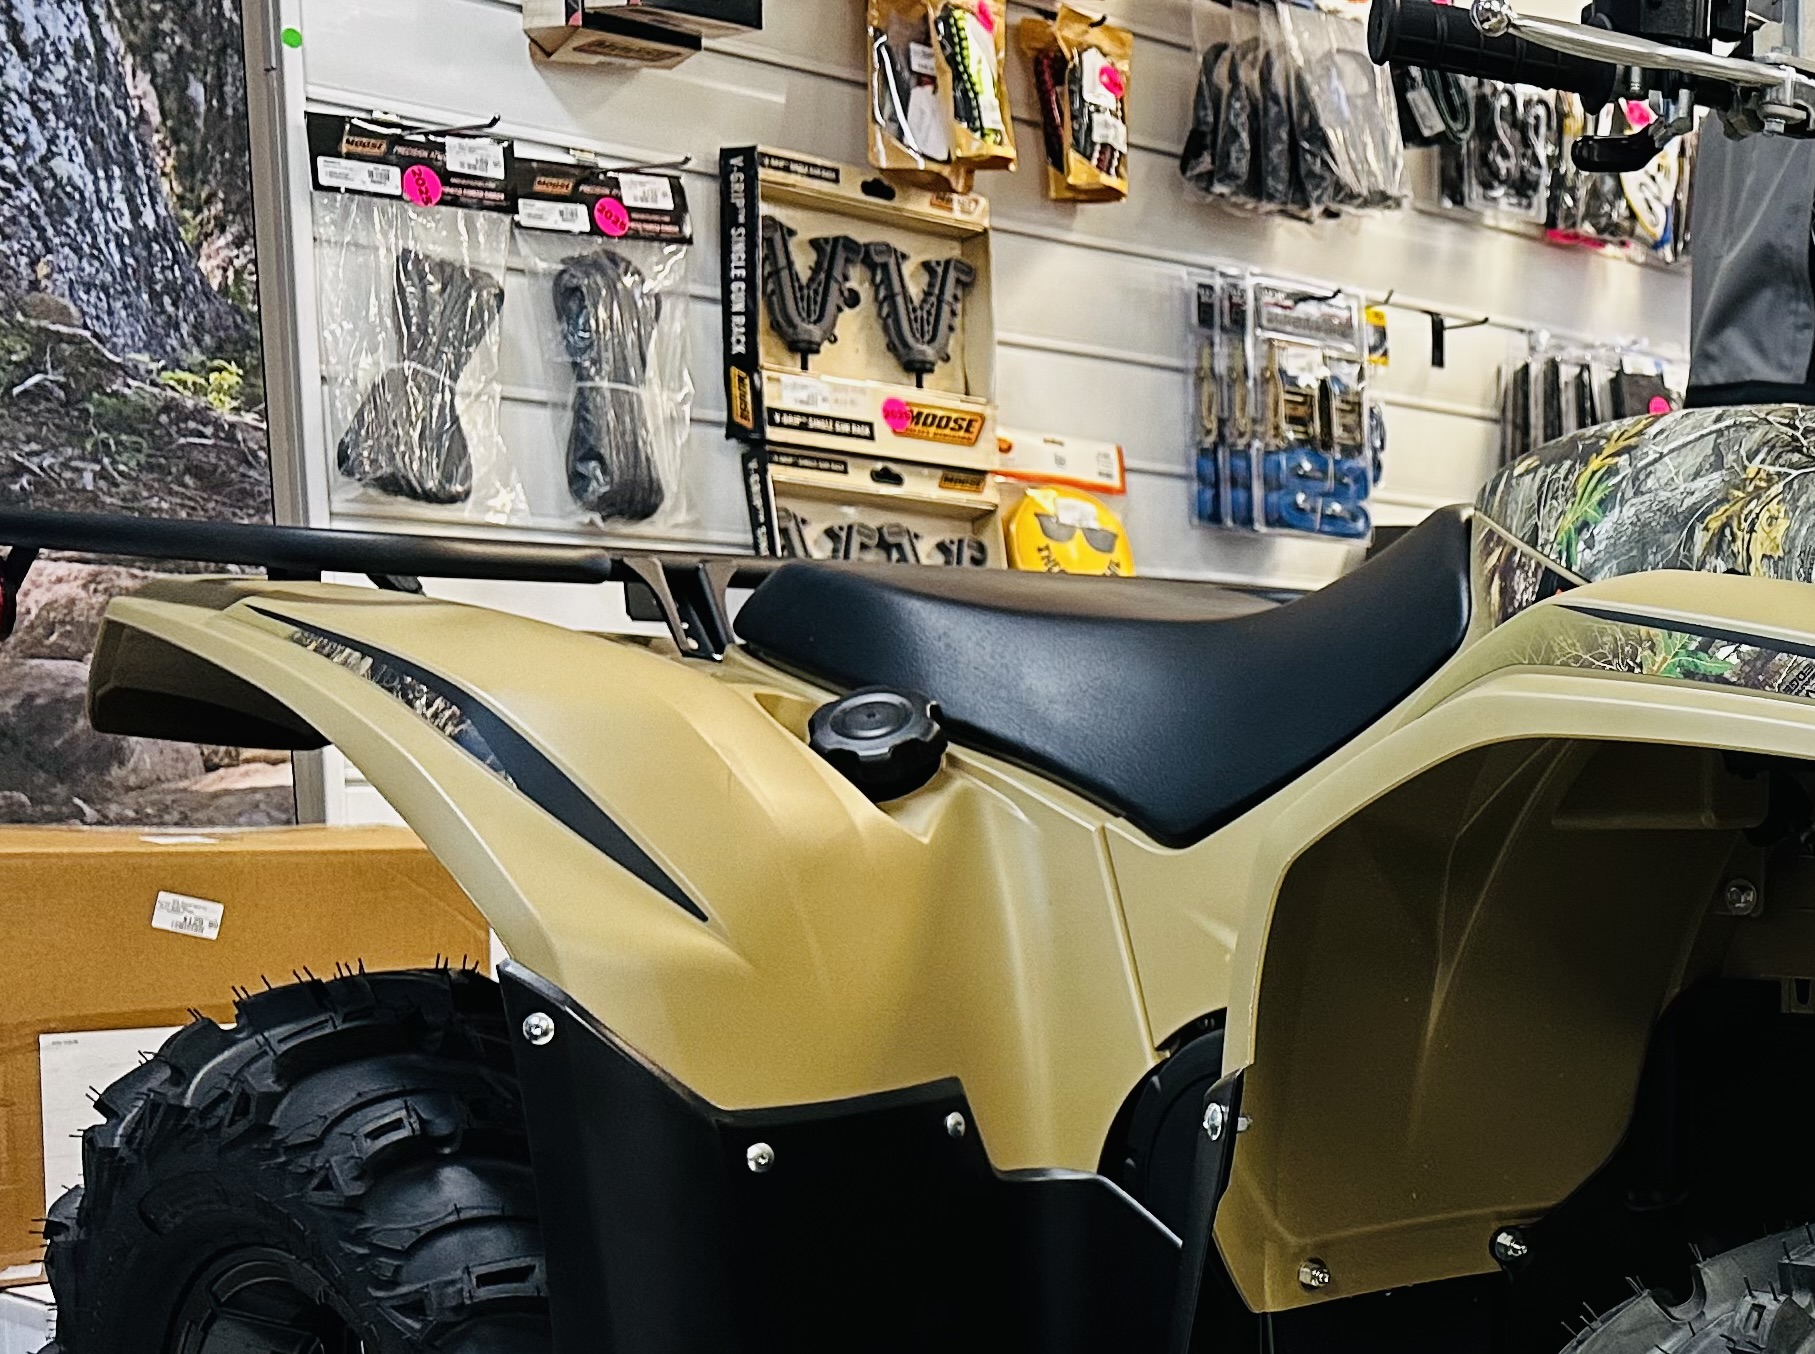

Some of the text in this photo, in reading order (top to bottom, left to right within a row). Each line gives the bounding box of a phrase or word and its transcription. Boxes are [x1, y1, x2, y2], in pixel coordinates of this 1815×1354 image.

[410, 167, 433, 206] 2025
[730, 226, 746, 280] SINGLE
[730, 281, 746, 313] GUN
[730, 314, 746, 355] RACK
[909, 408, 979, 435] MOOSE
